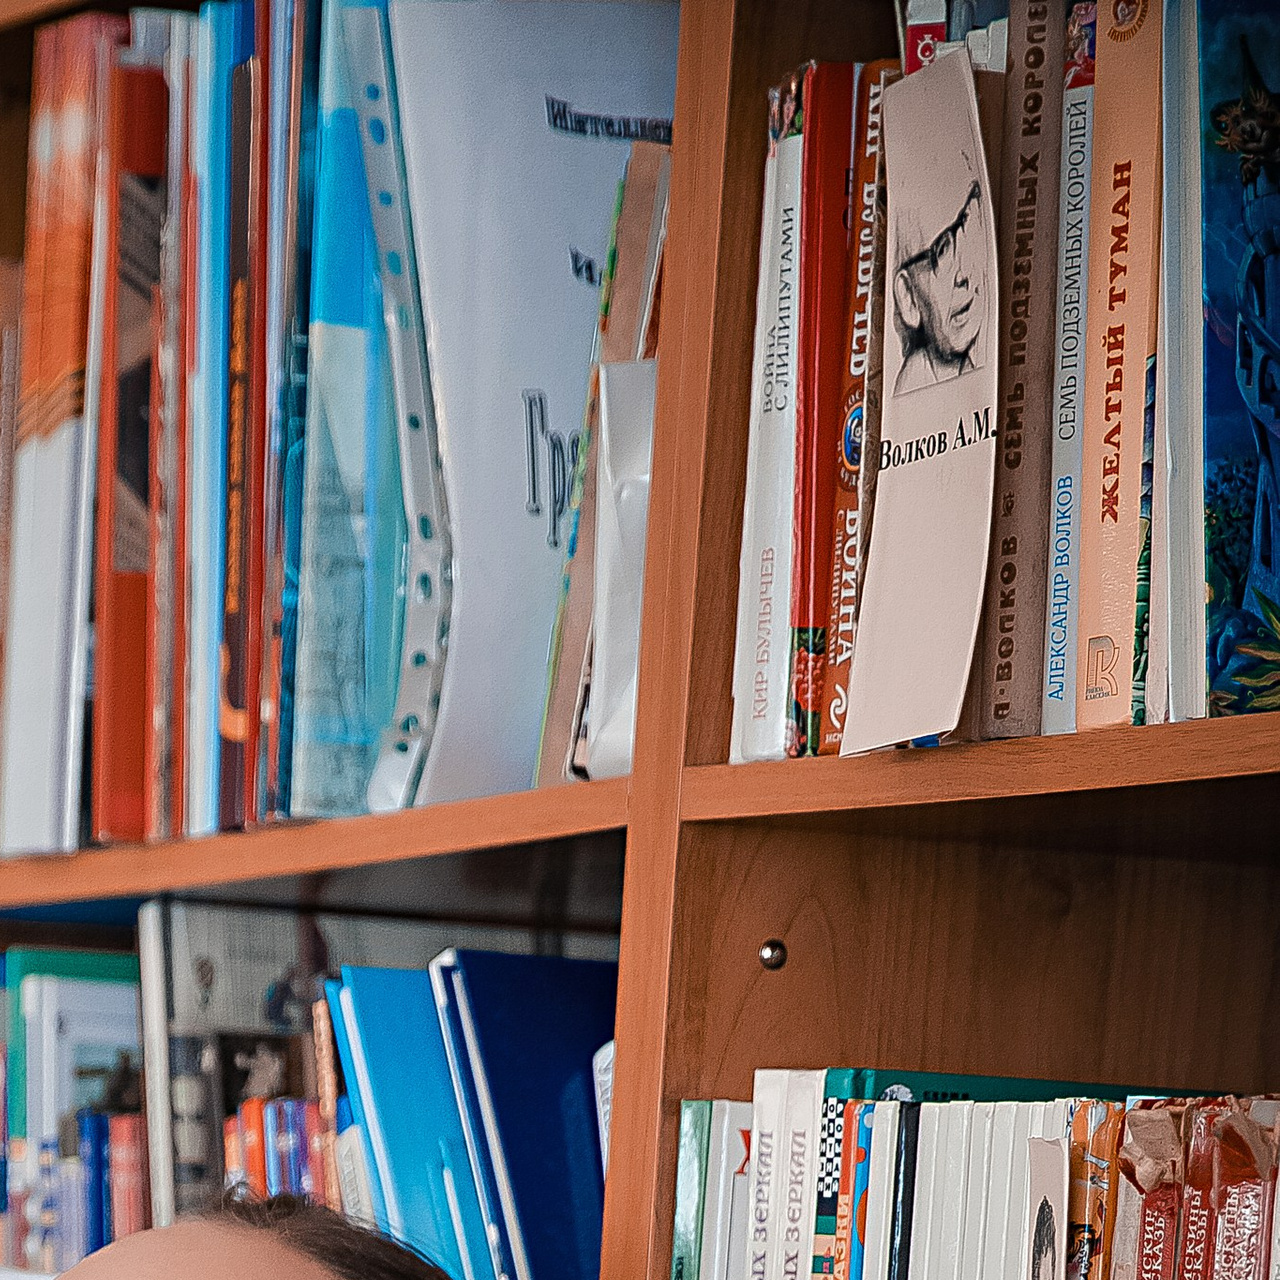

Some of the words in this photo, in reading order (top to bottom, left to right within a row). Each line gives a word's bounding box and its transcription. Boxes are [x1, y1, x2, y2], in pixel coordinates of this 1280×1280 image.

[1022, 0, 1048, 138] КОРОЛЕ
[1065, 98, 1088, 219] КОРОЛЕЙ
[1008, 151, 1040, 367] ПОДЗЕМНЫХ
[1061, 219, 1083, 370] ПОДЗЕМНЫХ
[1108, 160, 1133, 313] ТУМАН
[775, 205, 795, 388] ЛИЛИПУТАМИ
[762, 323, 778, 413] ВОЙНА
[774, 394, 787, 412] С
[1003, 382, 1024, 470] СЕМЬ
[1058, 372, 1078, 441] СЕМЬ
[1100, 323, 1126, 524] ЖЕЛТЫЙ
[879, 433, 948, 471] Волков
[952, 407, 997, 450] А.М.
[1054, 475, 1073, 566] ВОЛКОВ
[755, 546, 775, 665] БУЛЫЧЕВ
[1047, 572, 1071, 701] АЛЕКСАНДР
[752, 673, 768, 721] КИР
[753, 1130, 774, 1243] ЗЕРКАЛ
[785, 1129, 807, 1243] ЗЕРКАЛ
